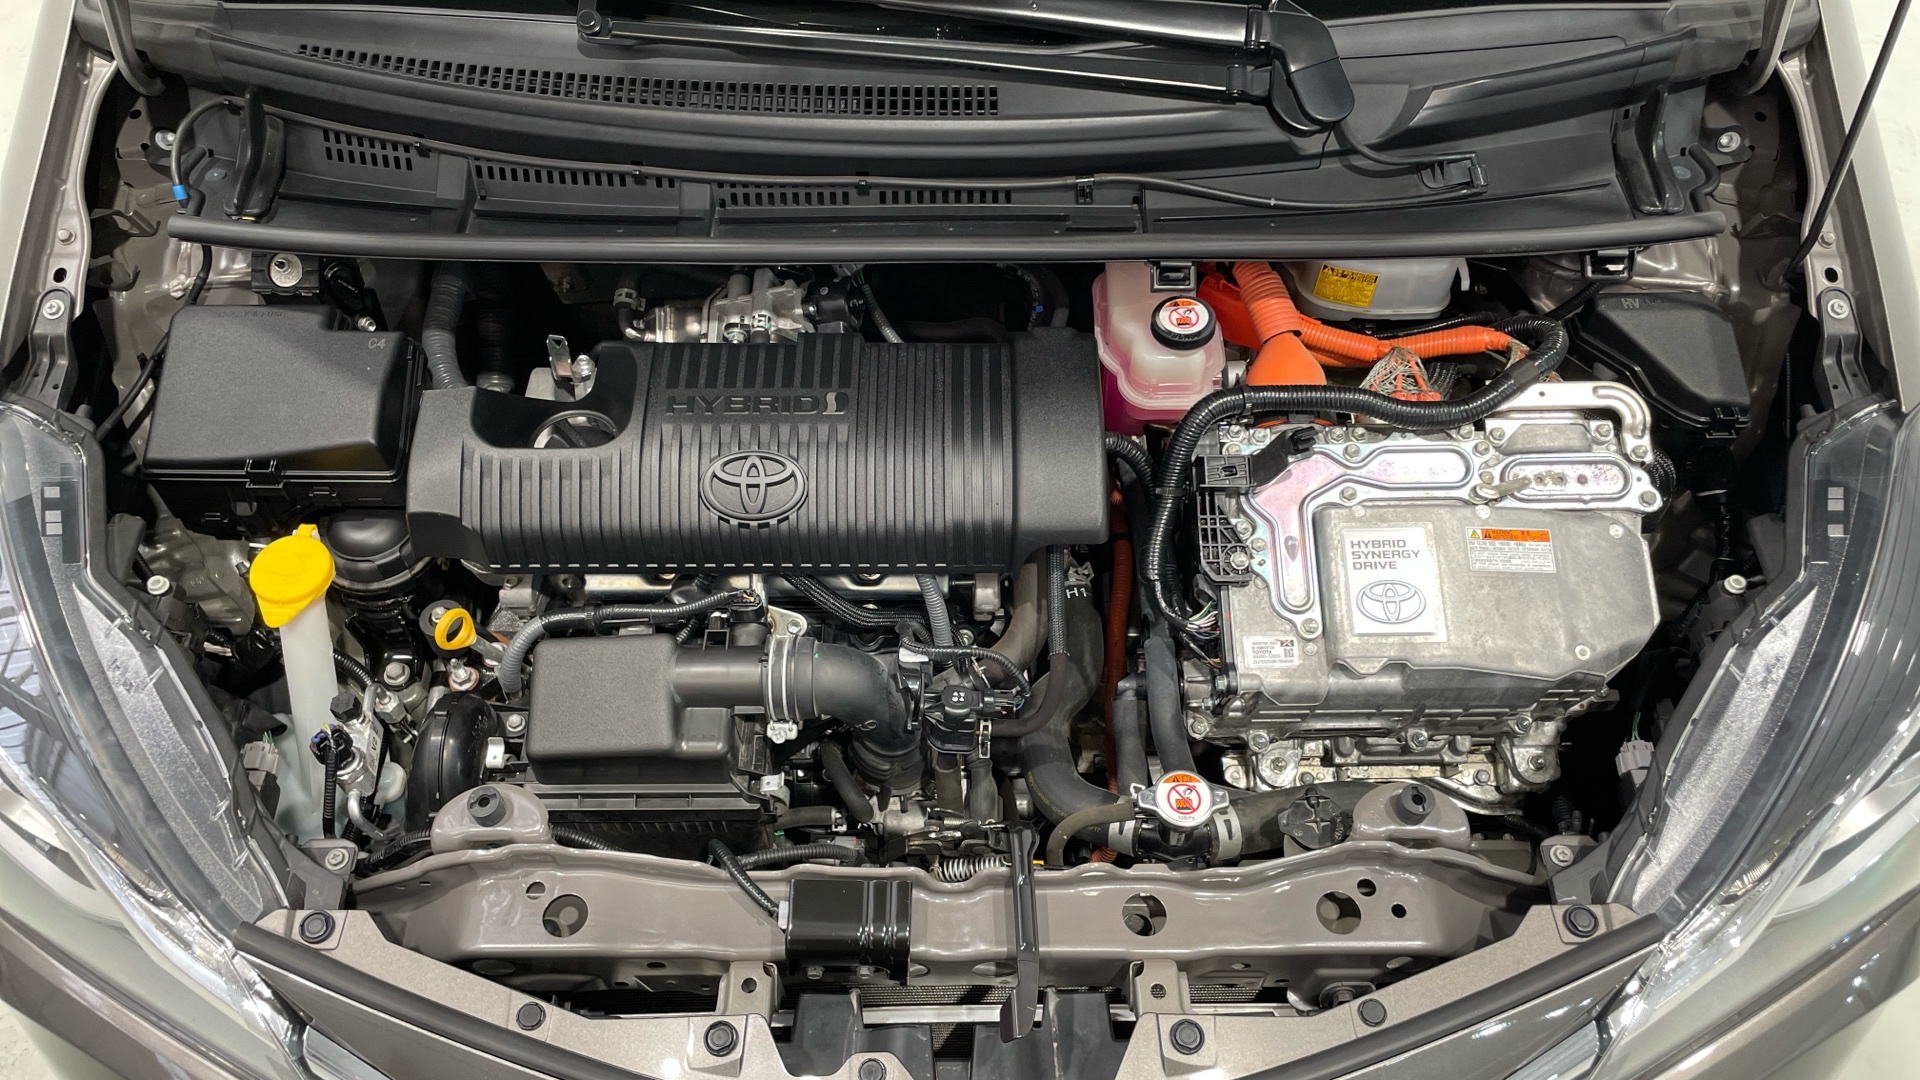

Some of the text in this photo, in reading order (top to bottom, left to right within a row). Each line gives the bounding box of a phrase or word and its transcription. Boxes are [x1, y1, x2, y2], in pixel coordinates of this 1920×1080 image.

[1620, 297, 1640, 309] HV
[666, 395, 820, 416] HYBRID
[1350, 539, 1406, 549] HYBRID
[1351, 549, 1420, 560] SYNERGY
[1353, 561, 1398, 570] DRIVE
[1066, 587, 1087, 599] H1
